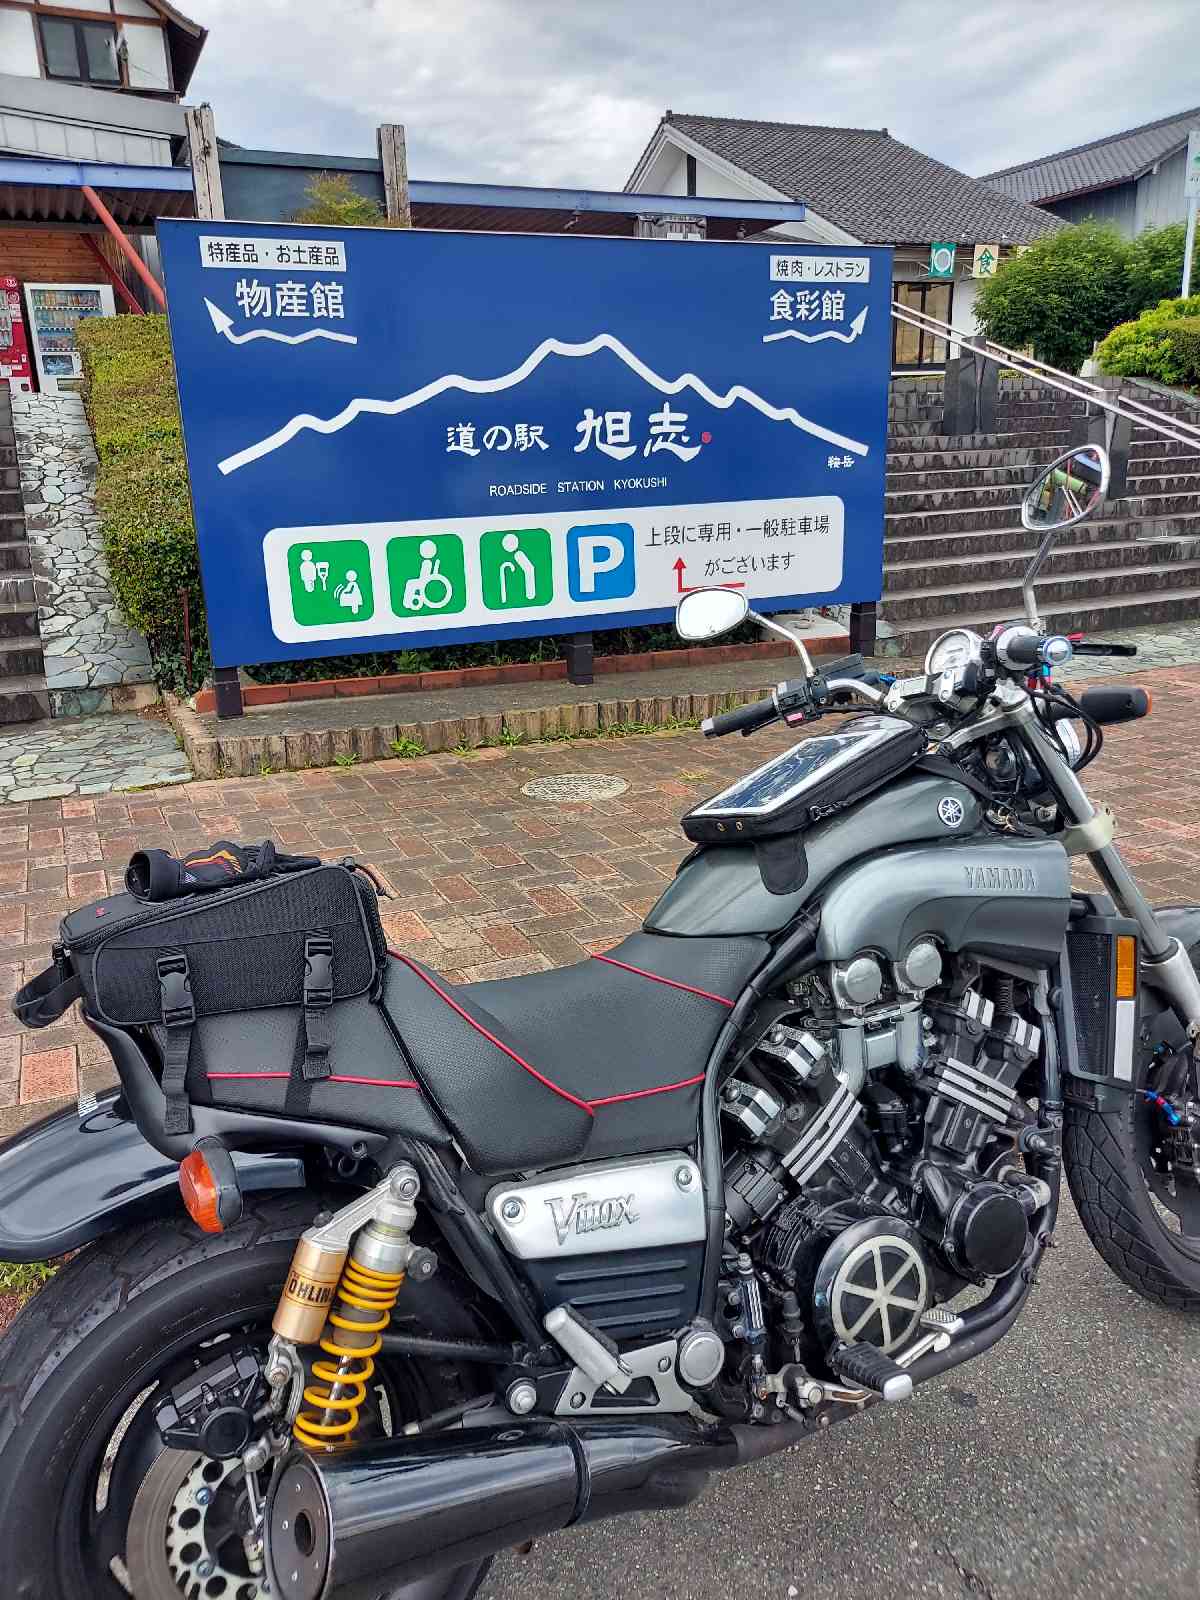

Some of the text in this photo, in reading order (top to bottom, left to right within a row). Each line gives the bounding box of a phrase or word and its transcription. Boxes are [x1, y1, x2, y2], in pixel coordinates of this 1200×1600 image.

[207, 242, 340, 265] 特産品・お土産品
[976, 247, 995, 274] 食
[776, 259, 865, 278] 焼肉・レストラン
[235, 278, 345, 319] 物産館
[769, 288, 846, 321] 食彩館
[446, 401, 702, 462] 道の駅 旭志
[489, 476, 668, 497] ROADSIDE STATION KYOKUSHI
[644, 514, 831, 547] 上段に専用・一般駐車場
[577, 535, 625, 593] P
[704, 551, 796, 577] がございます
[963, 865, 1038, 890] YAMAHA
